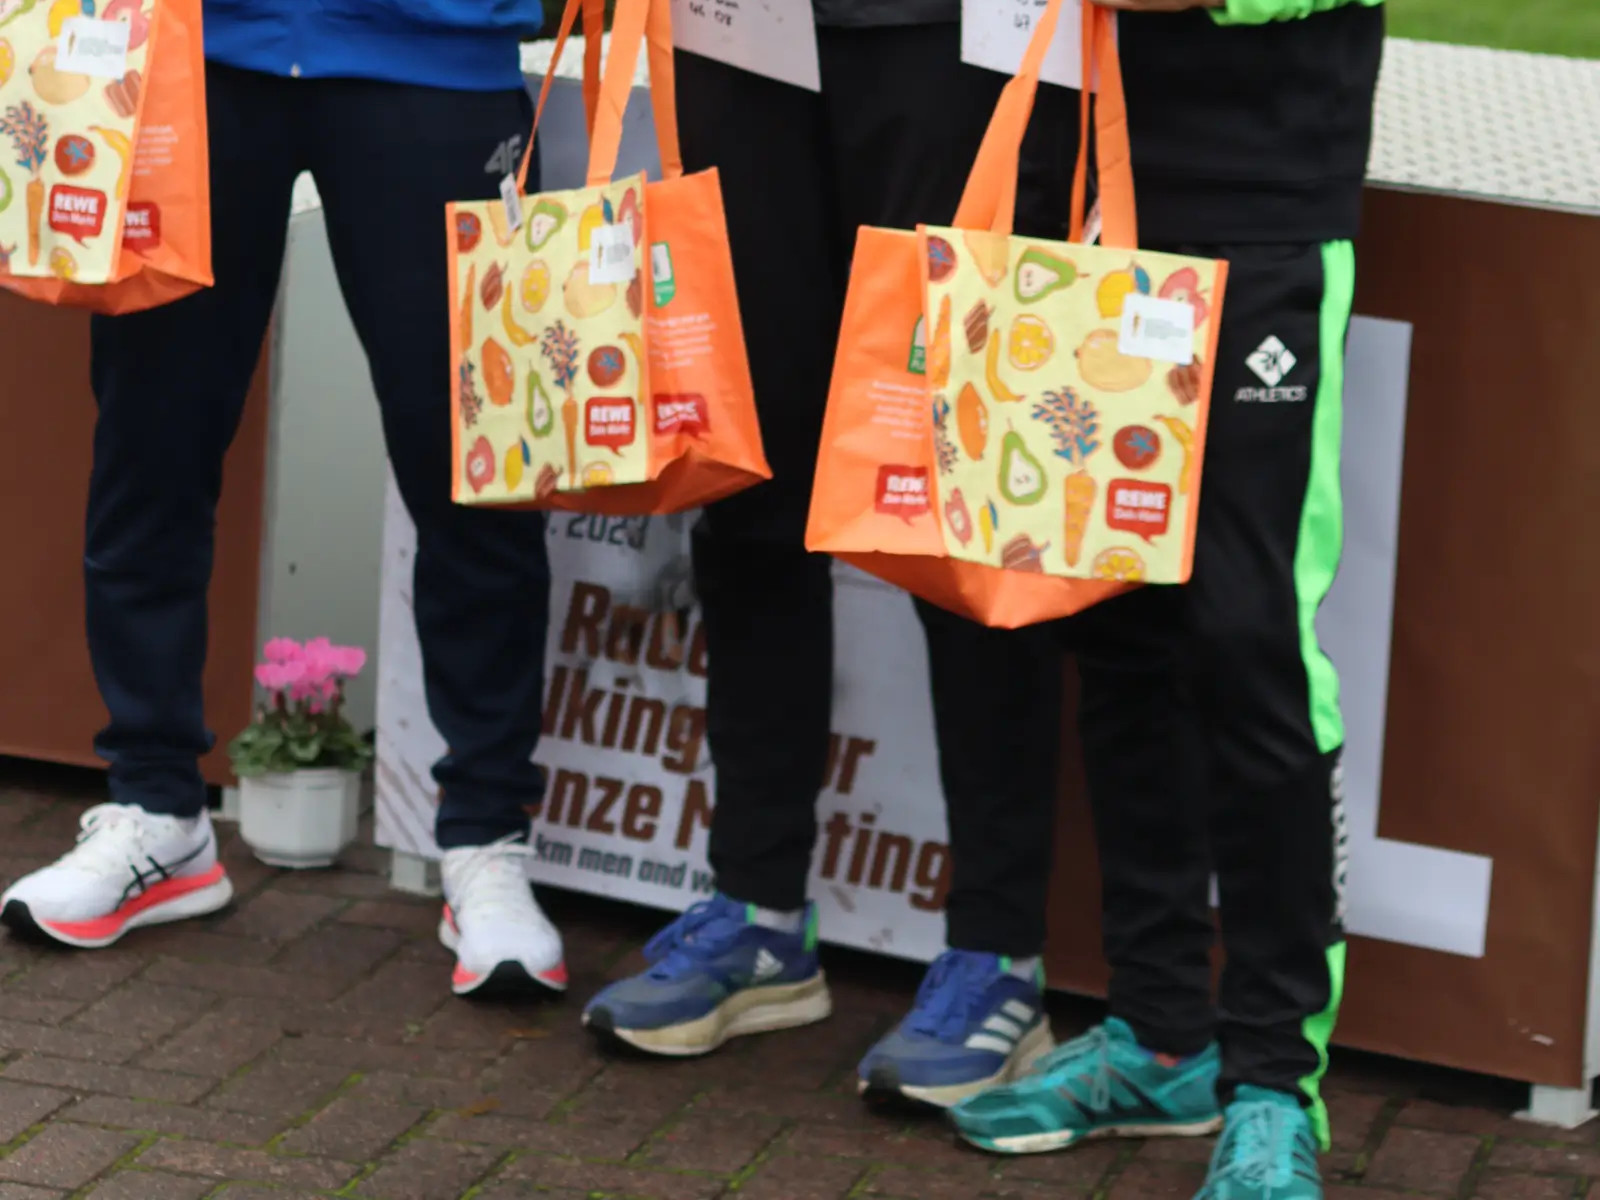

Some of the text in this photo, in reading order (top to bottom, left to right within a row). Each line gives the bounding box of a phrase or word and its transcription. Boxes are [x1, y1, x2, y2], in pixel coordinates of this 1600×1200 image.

[484, 134, 521, 174] 4F
[54, 192, 98, 215] REWE
[126, 209, 150, 226] WE
[1234, 385, 1308, 403] ATHLETICS
[590, 404, 631, 423] REWE
[1114, 487, 1167, 510] REWE
[540, 666, 706, 775] lking
[577, 846, 633, 879] men
[638, 858, 688, 890] and
